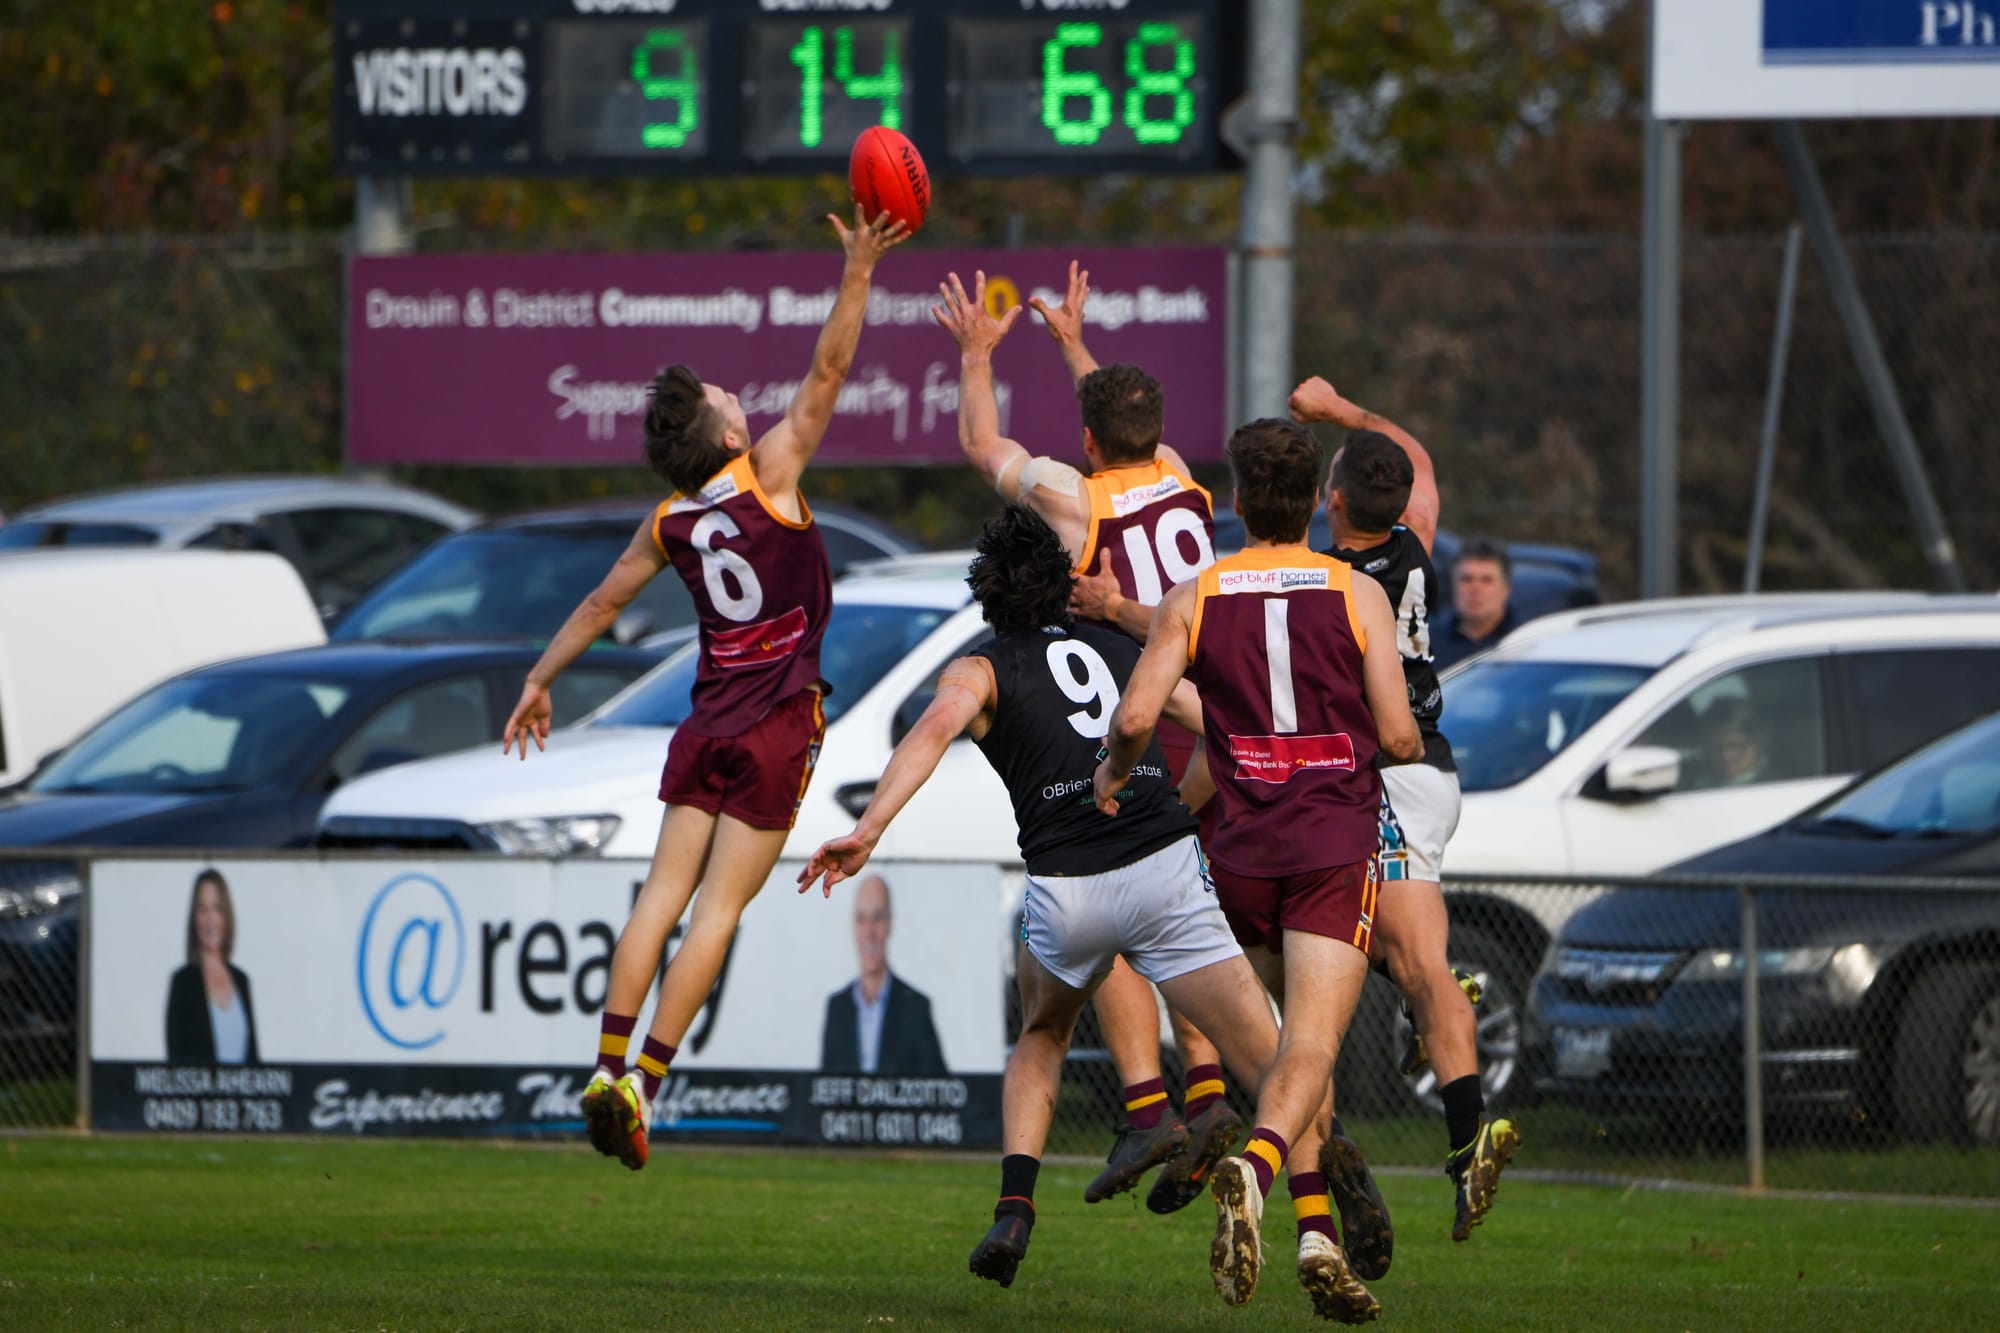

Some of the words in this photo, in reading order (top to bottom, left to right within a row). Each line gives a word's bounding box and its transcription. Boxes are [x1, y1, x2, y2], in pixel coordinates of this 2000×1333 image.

[353, 48, 526, 116] VISITORS
[631, 29, 697, 148] 9
[791, 26, 900, 147] 14
[1042, 22, 1194, 144] 68
[366, 288, 459, 328] Drouin
[463, 288, 487, 327] &
[493, 288, 596, 328] District
[600, 288, 762, 332] Community
[1137, 284, 1207, 324] Bank
[690, 510, 763, 622] 6
[1220, 574, 1243, 586] red
[1247, 572, 1276, 584] bluff
[1281, 571, 1327, 581] homes
[1046, 638, 1121, 738] 9
[1264, 599, 1298, 732] 1
[1333, 757, 1350, 765] Bank
[309, 1079, 502, 1130] Experience
[650, 1075, 788, 1126] fference
[809, 1077, 854, 1107] JEFF
